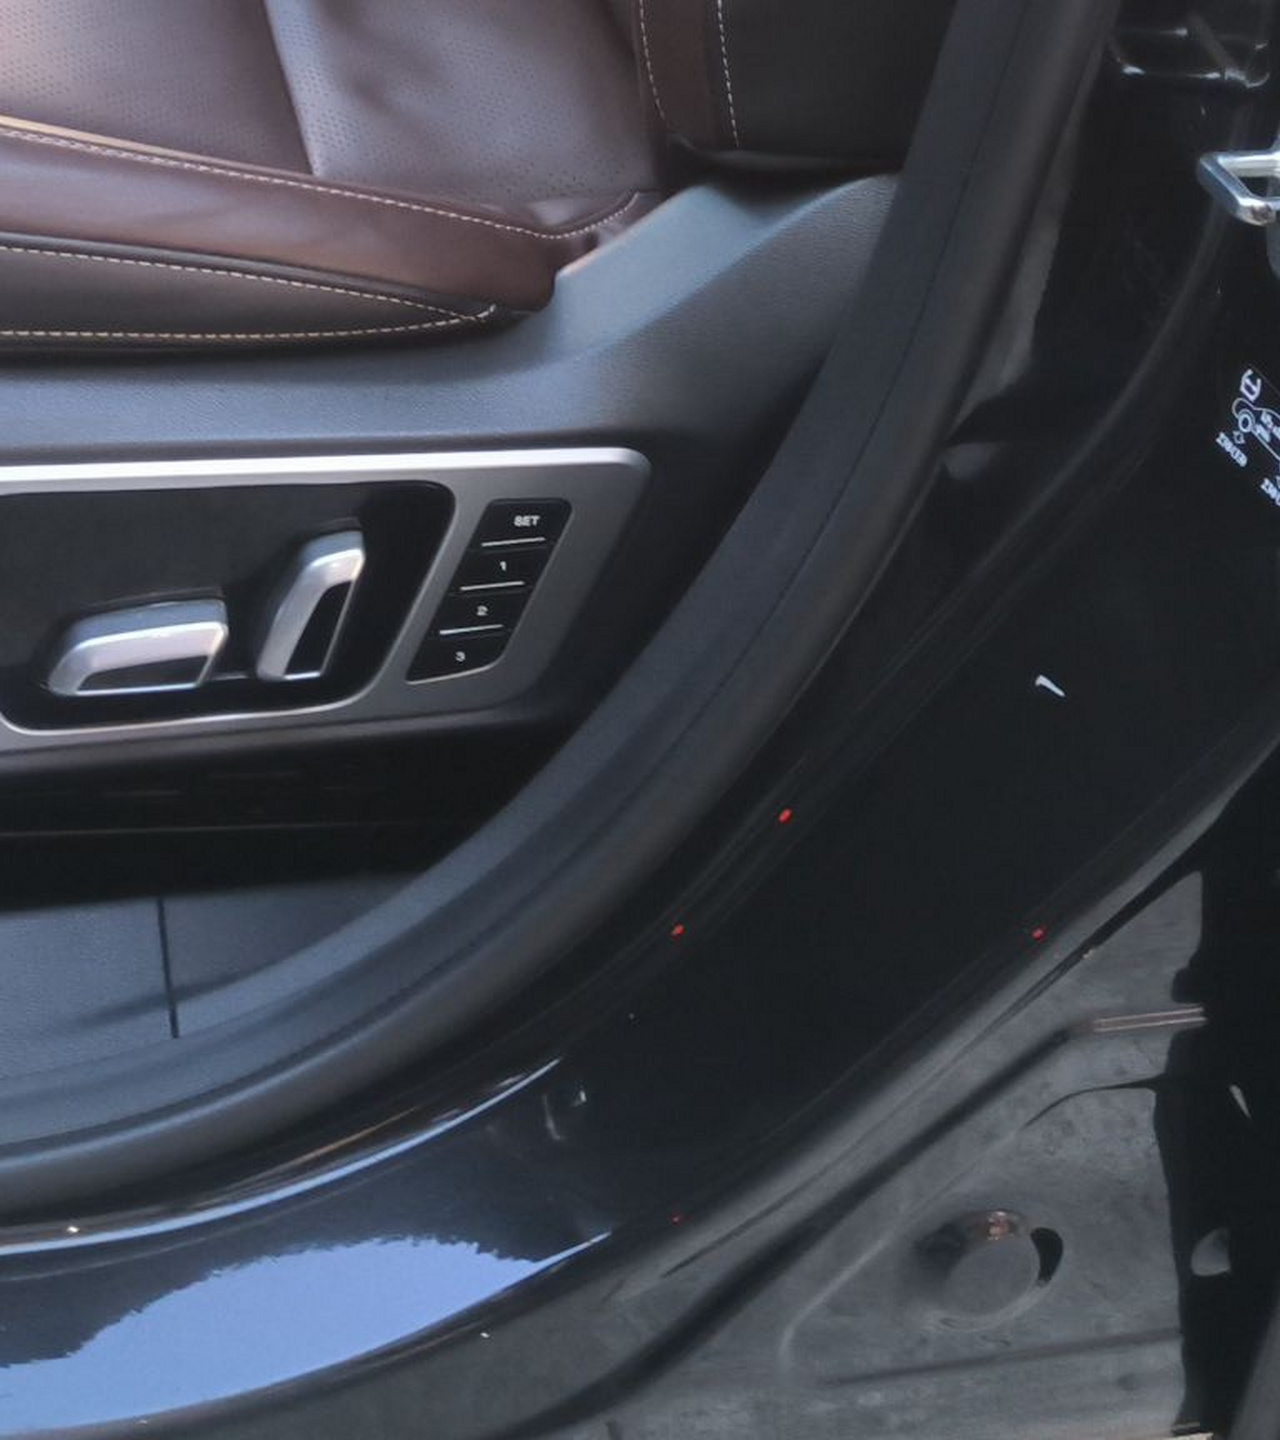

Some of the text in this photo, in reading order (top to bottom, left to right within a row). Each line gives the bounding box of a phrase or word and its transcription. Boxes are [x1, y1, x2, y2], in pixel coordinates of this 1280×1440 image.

[513, 515, 541, 527] SET
[499, 560, 507, 572] 1
[476, 605, 488, 617] 2
[455, 650, 466, 662] 3
